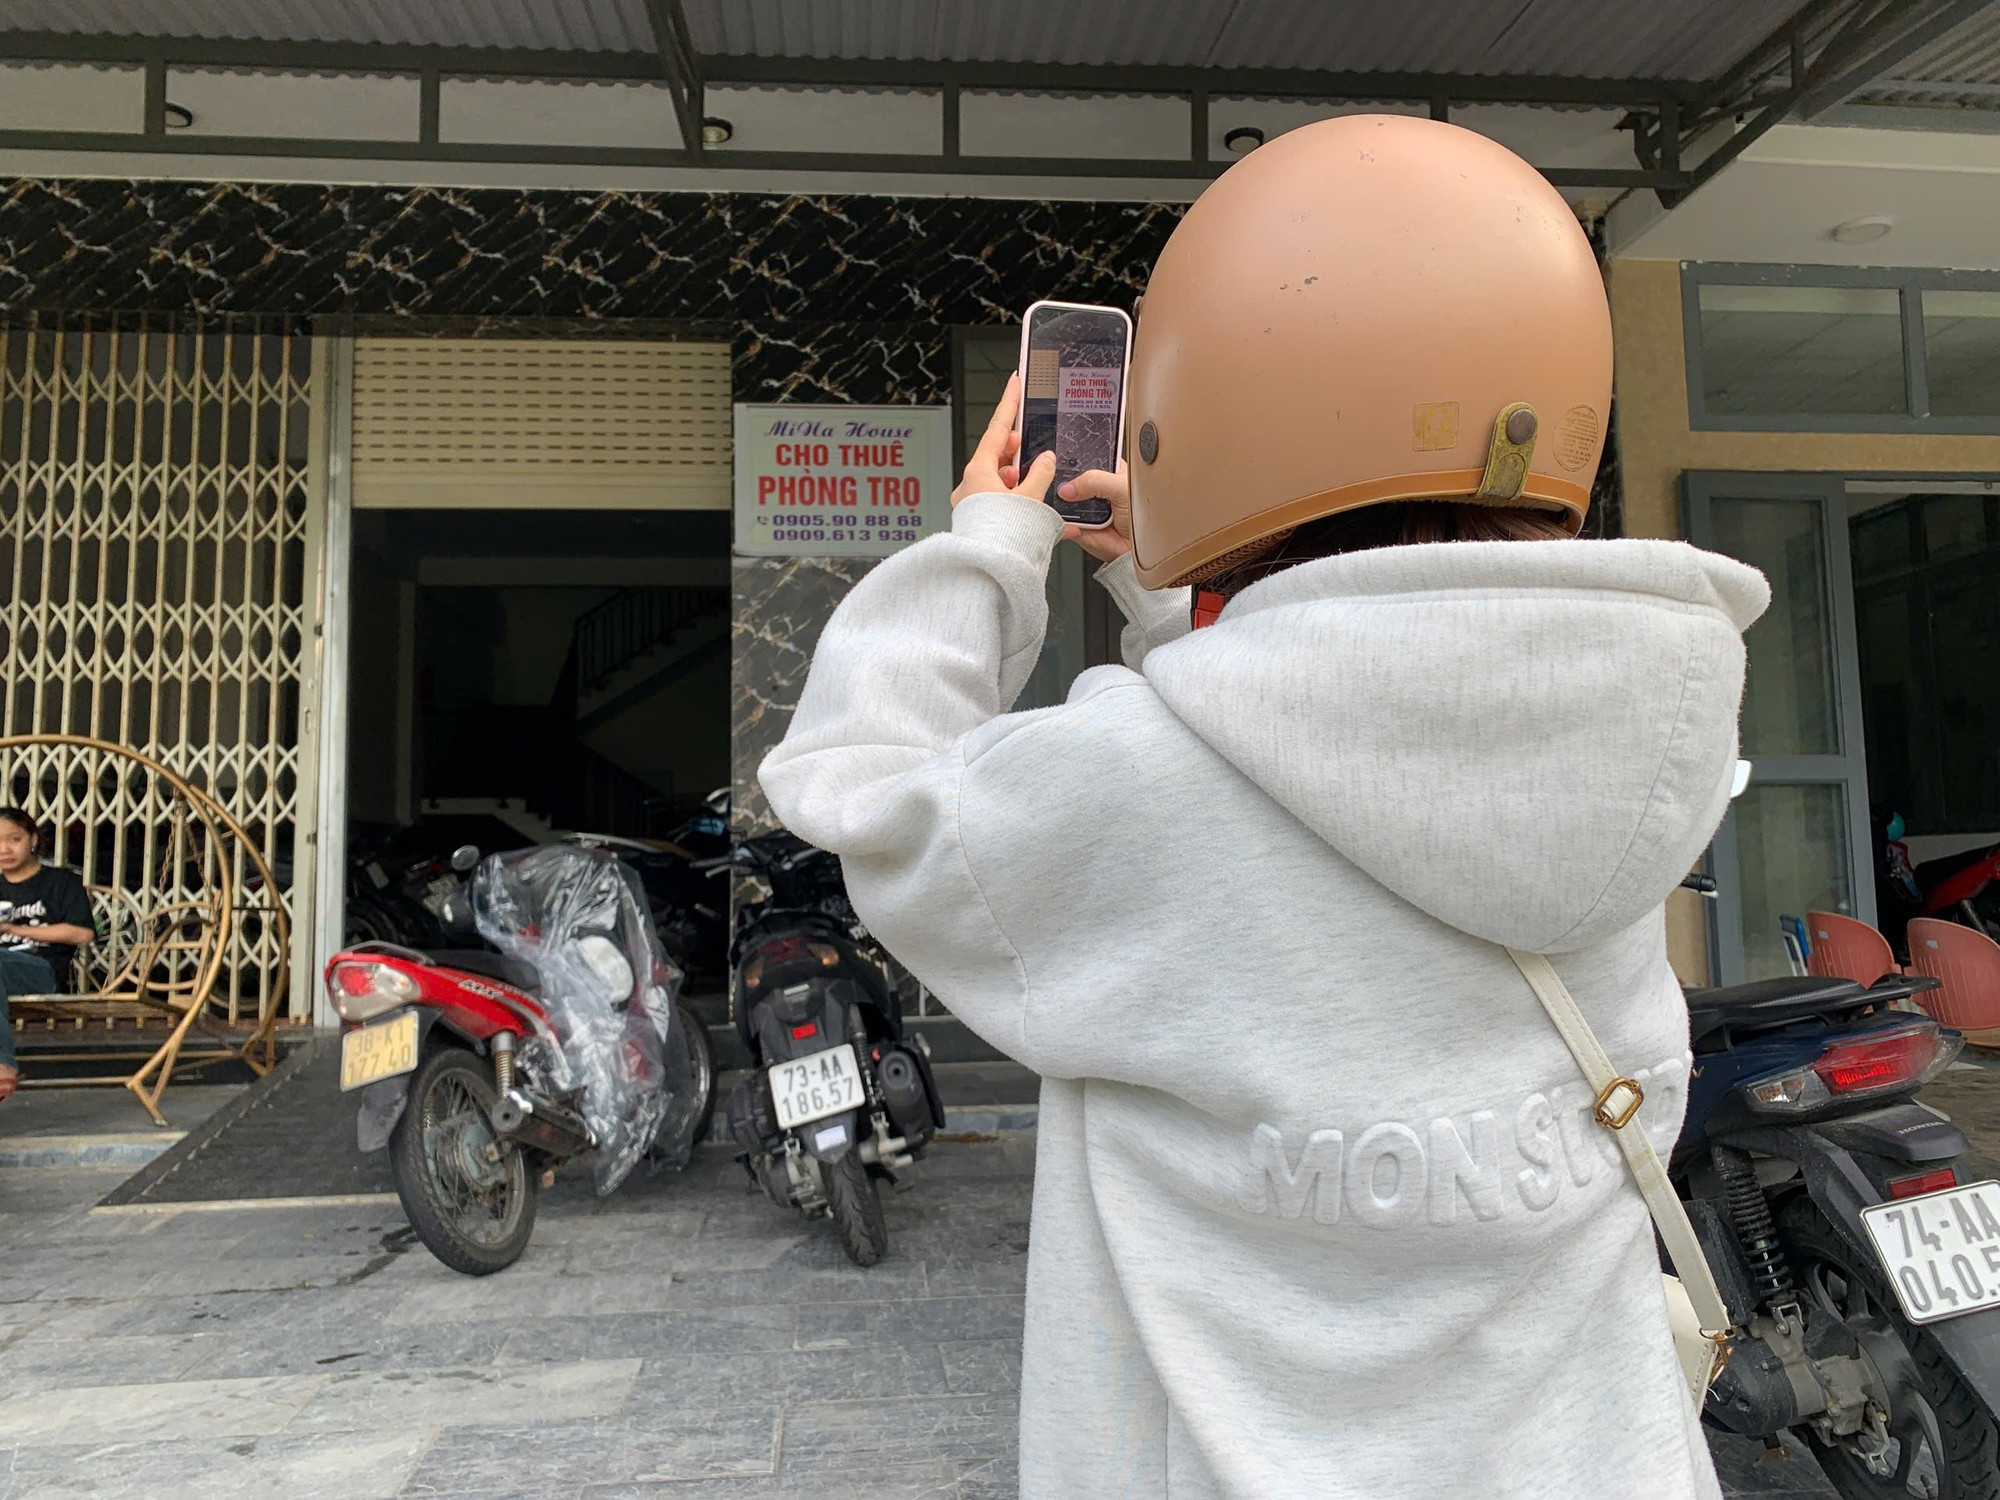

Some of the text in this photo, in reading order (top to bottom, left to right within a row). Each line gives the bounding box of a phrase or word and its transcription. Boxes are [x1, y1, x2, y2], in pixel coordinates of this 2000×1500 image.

[1070, 378, 1087, 387] CHO
[845, 421, 915, 438] House
[775, 440, 905, 467] CHO THUÊ
[758, 468, 921, 513] PHÒNG TRỌ
[773, 514, 922, 527] 0905.90 88 68
[878, 529, 917, 541] 936
[783, 1053, 844, 1092] 73-AA
[783, 1077, 854, 1120] 186.57
[1896, 1121, 1946, 1135] HONDA
[1885, 1193, 2000, 1258] 74-AA
